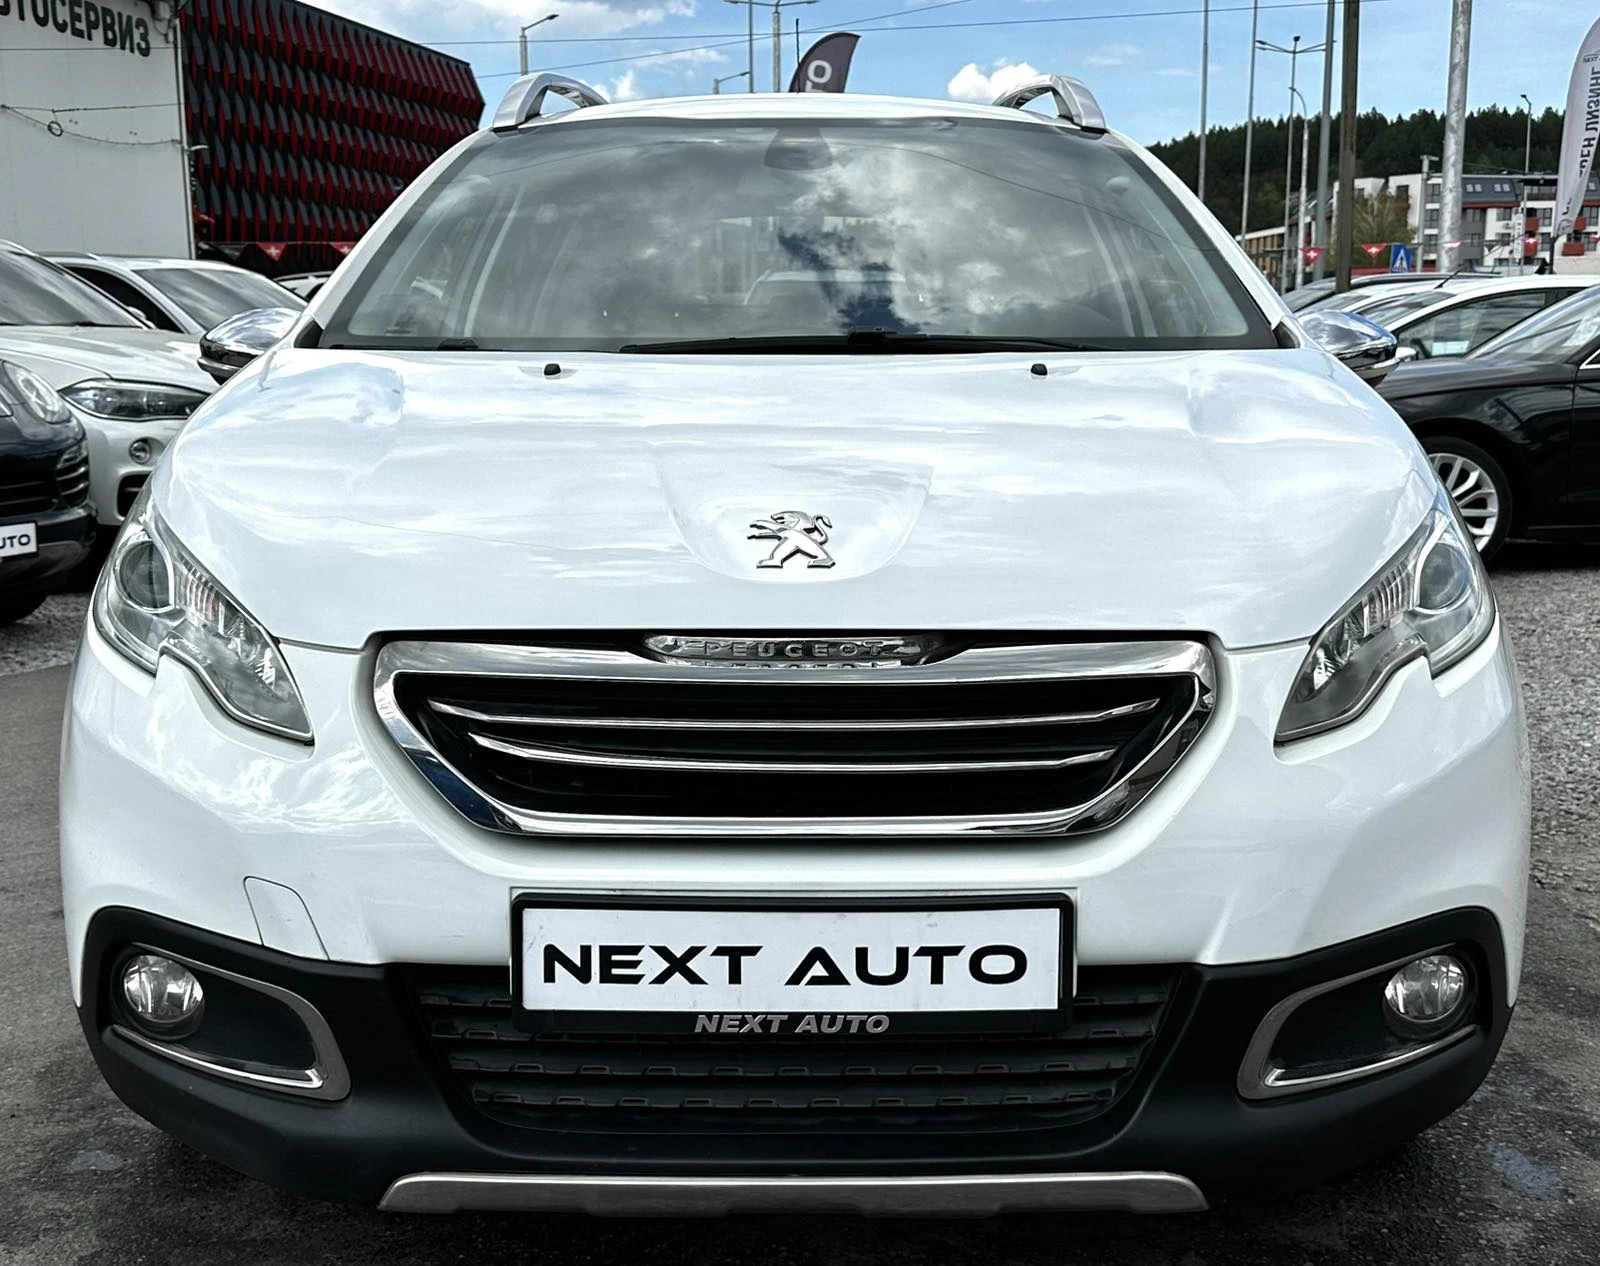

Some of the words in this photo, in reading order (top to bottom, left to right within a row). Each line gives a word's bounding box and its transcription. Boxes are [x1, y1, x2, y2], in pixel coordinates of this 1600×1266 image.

[704, 639, 884, 657] PEUGEOT
[543, 944, 763, 985] NEXT
[785, 945, 1028, 986] AUTO
[694, 1014, 789, 1034] NEXT
[795, 1014, 890, 1034] AUTO
